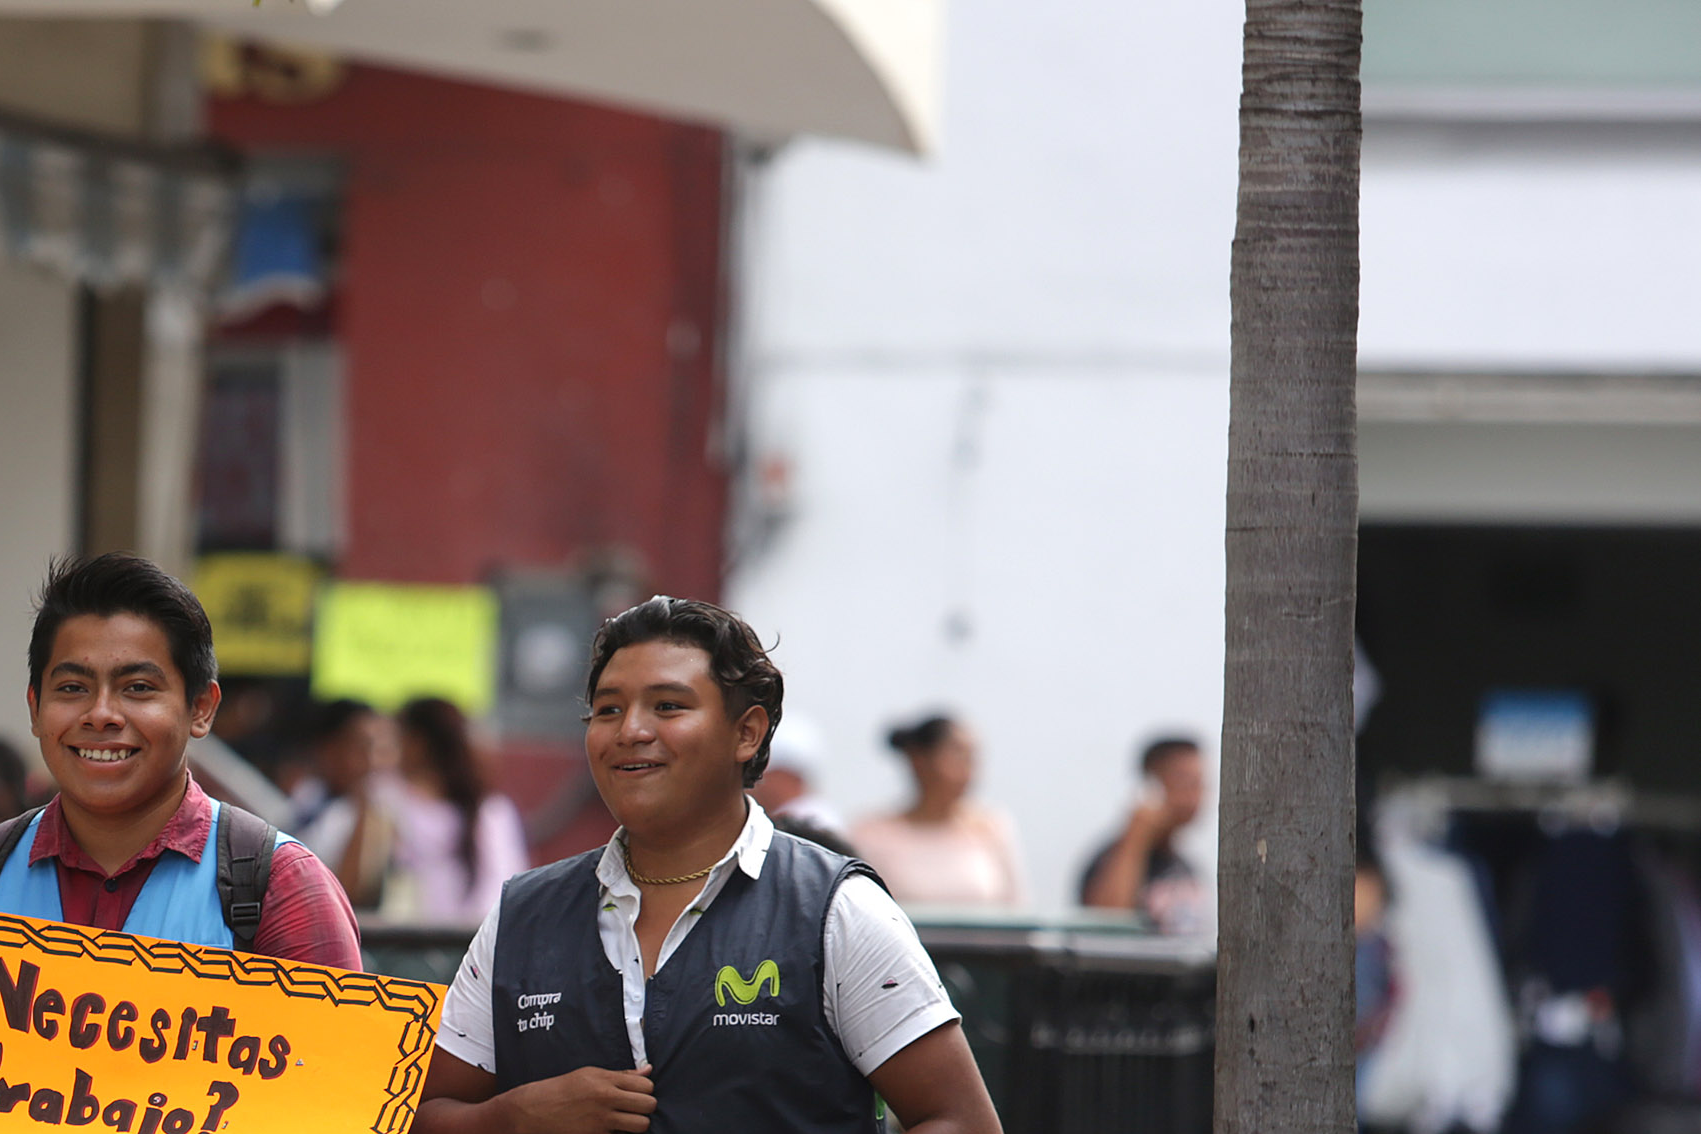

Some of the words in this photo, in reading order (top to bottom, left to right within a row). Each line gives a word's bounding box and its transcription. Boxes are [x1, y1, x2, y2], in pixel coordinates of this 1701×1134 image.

[517, 990, 562, 1010] Compra
[517, 1017, 527, 1032] tu
[529, 1011, 555, 1031] chip
[713, 1010, 780, 1027] movistar
